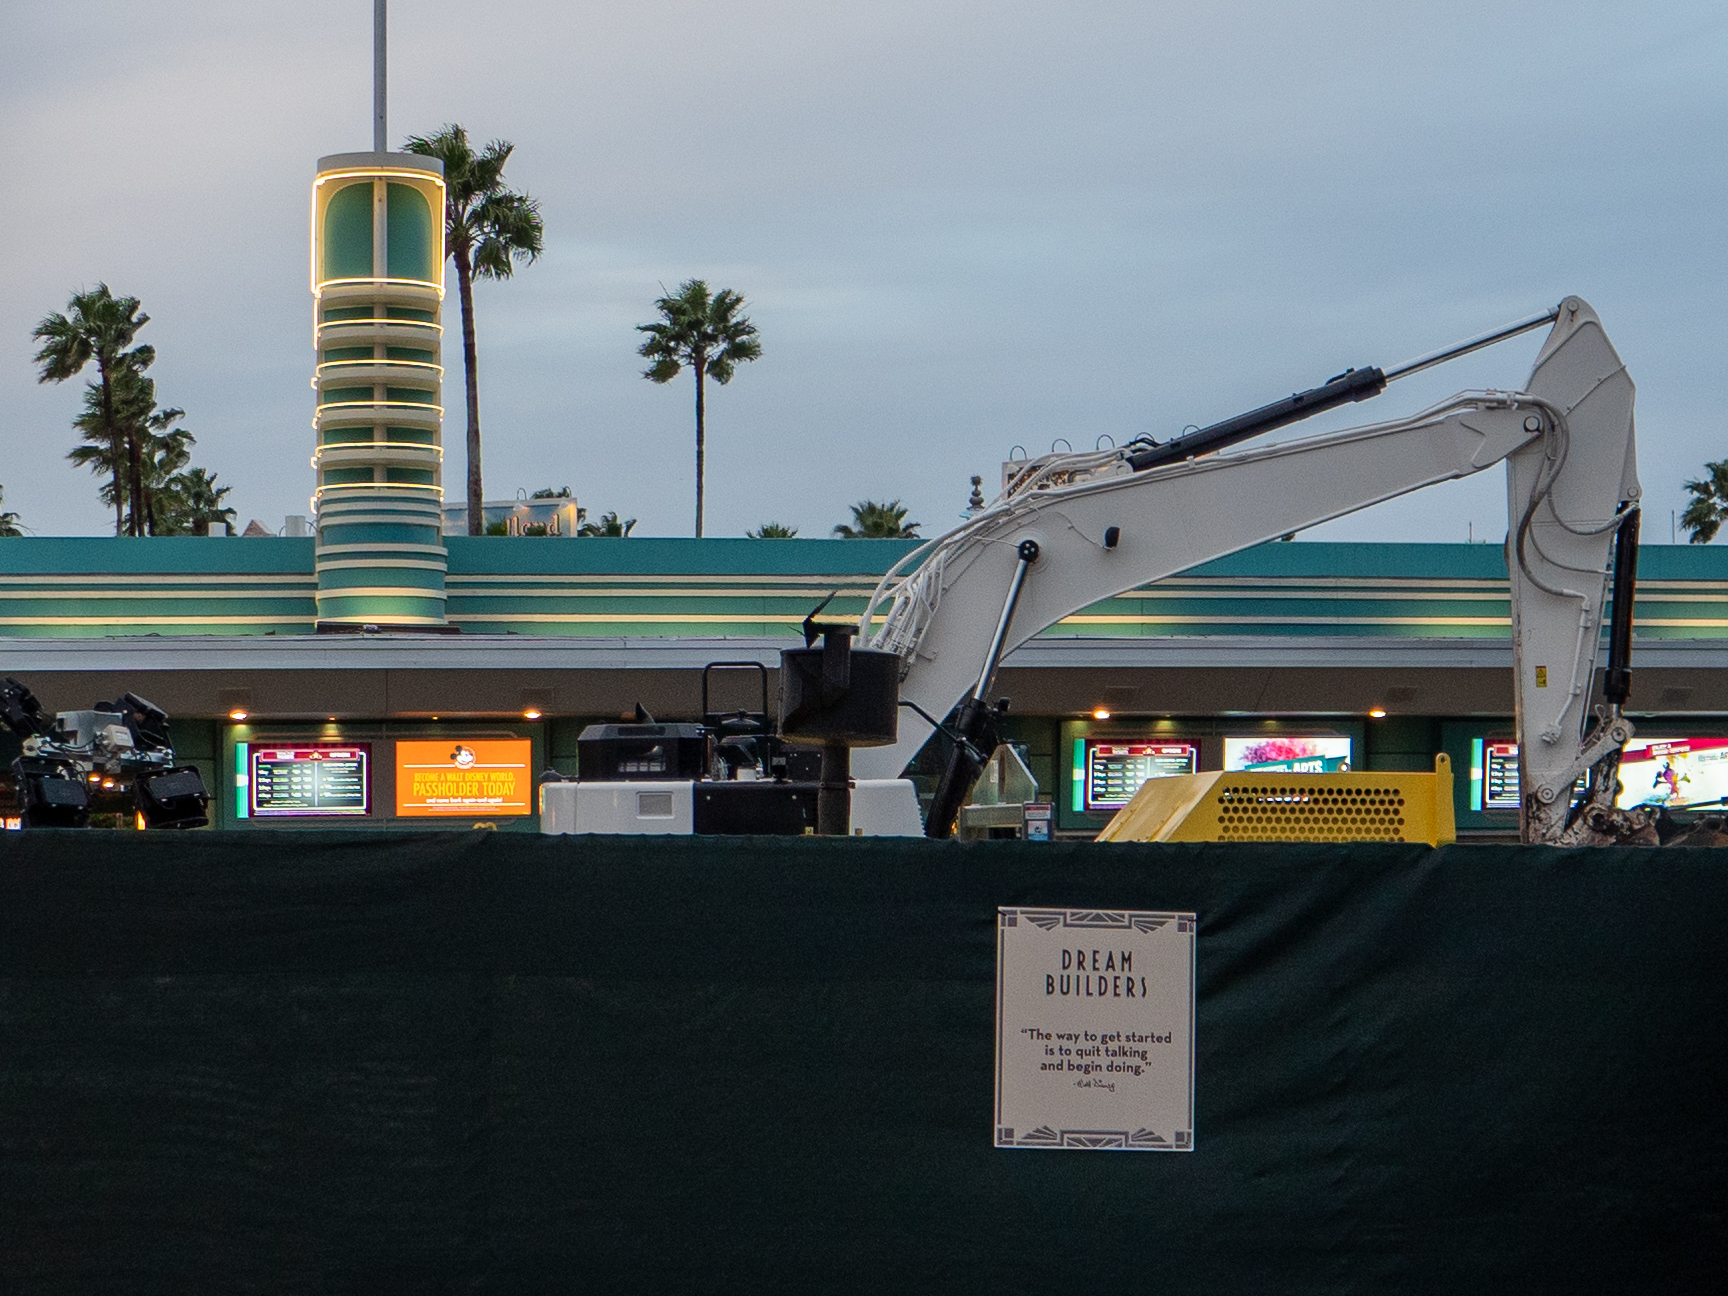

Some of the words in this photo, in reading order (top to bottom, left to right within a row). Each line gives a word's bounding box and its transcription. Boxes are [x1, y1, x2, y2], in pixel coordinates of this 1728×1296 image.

[414, 772, 439, 781] BECOME
[446, 772, 463, 781] WALT
[465, 772, 488, 781] DISNEY
[413, 782, 479, 796] PASSHOLDER
[482, 782, 515, 795] TODAY
[1062, 949, 1132, 972] DREAM
[1046, 974, 1148, 998] BUILDERS
[1021, 1028, 1052, 1041] “The
[1056, 1032, 1080, 1044] way
[1084, 1030, 1097, 1042] to
[1101, 1031, 1122, 1045] get
[1125, 1031, 1172, 1044] started
[1045, 1045, 1055, 1056] is
[1059, 1045, 1072, 1056] to
[1076, 1046, 1101, 1059] quit
[1105, 1046, 1148, 1061] talking
[1040, 1059, 1064, 1071] and
[1067, 1059, 1102, 1074] begin
[1106, 1060, 1152, 1076] doing.”
